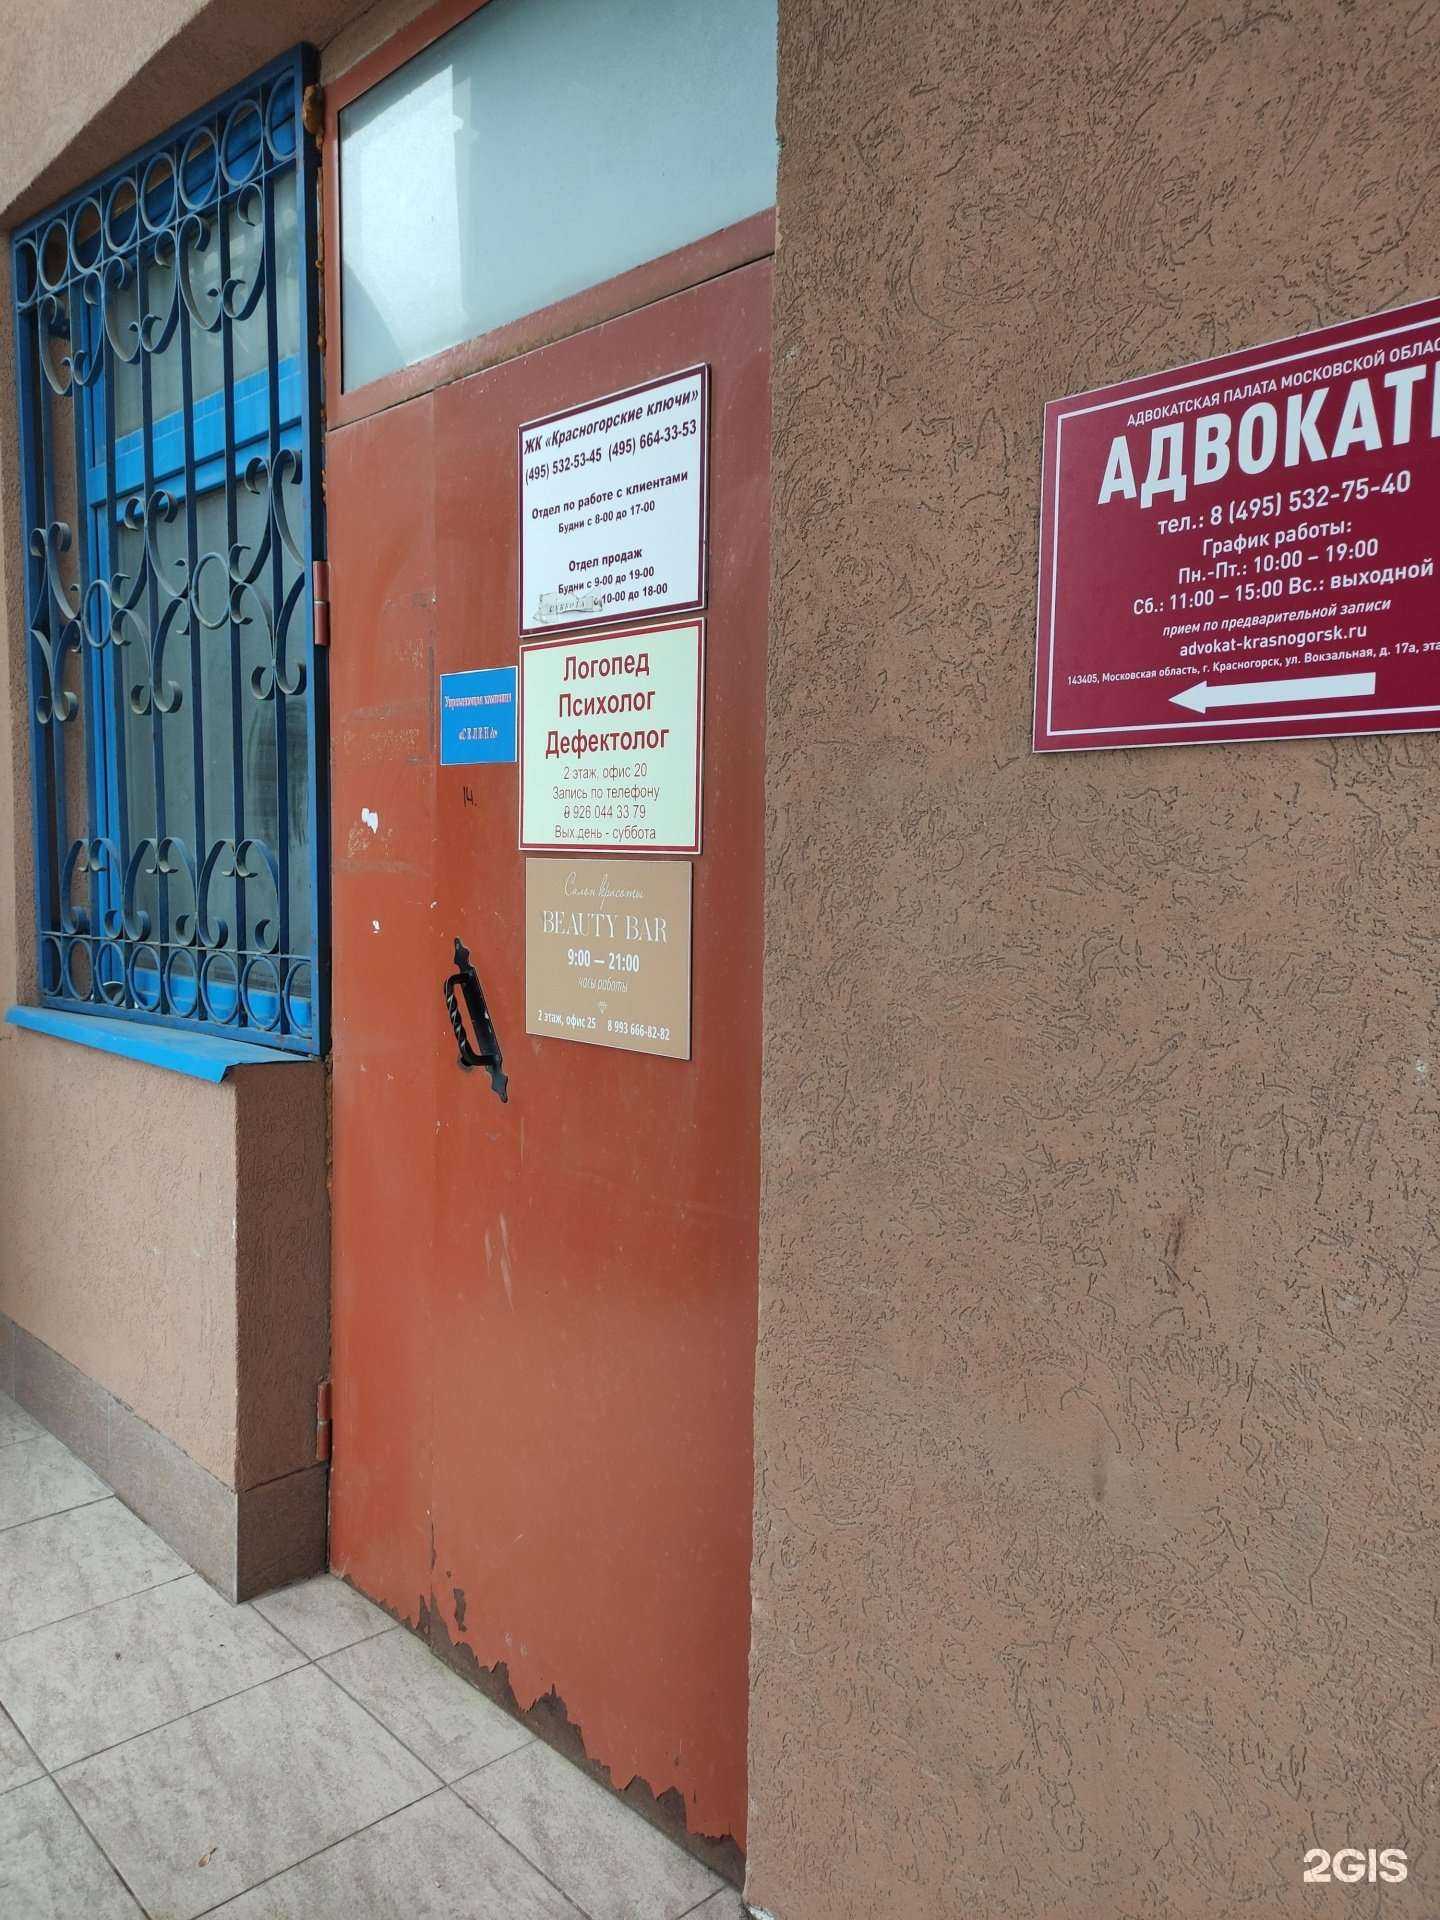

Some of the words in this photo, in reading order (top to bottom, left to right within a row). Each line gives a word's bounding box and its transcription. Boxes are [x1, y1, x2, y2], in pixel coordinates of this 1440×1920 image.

[1127, 393, 1220, 427] АДВОКАТСКАЯ
[1223, 380, 1278, 403] ПАЛАТА
[1281, 349, 1386, 389] МОСКОВСКОЙ
[524, 433, 542, 455] ЖК
[545, 406, 643, 448] «Красногорские
[647, 389, 699, 417] ключи»
[525, 464, 550, 486] (495)
[552, 448, 601, 475] 532-53-45
[608, 437, 636, 462] (495)
[639, 419, 697, 449] 664-33-53
[532, 504, 560, 520] Отдел
[563, 500, 575, 512] по
[578, 490, 613, 511] работе
[616, 487, 622, 498] с
[626, 470, 688, 495] клиентами
[1157, 514, 1204, 535] тел.:
[1210, 505, 1222, 526] 8
[1229, 491, 1282, 525] (495)
[1288, 469, 1411, 512] 532-75-40
[558, 520, 585, 535] Будни
[587, 517, 592, 526] с
[595, 510, 613, 524] 8-00
[615, 510, 627, 521] до
[630, 500, 655, 516] 17-00
[1202, 532, 1270, 558] График
[1274, 521, 1352, 548] работы:
[569, 557, 599, 572] Отдел
[602, 547, 642, 568] продаж
[1178, 561, 1247, 585] Пн.-Пт.:
[1254, 550, 1302, 573] 10:00
[1326, 538, 1379, 563] 19:00
[558, 581, 584, 596] Будни
[586, 579, 592, 589] с
[594, 573, 613, 587] 9-00
[615, 573, 627, 585] до
[630, 566, 655, 581] 19-00
[602, 590, 626, 604] 10-00
[628, 589, 639, 601] до
[643, 583, 668, 597] 18-00
[1133, 597, 1164, 615] Сб.:
[1170, 589, 1214, 610] 11:00
[1235, 579, 1283, 601] 15:00
[1289, 577, 1324, 595] Вс.:
[1330, 558, 1434, 589] выходной
[1162, 623, 1200, 639] прием
[1203, 620, 1218, 632] по
[1221, 604, 1337, 630] предварительной
[1340, 599, 1391, 616] записи
[1180, 625, 1367, 656] advokat-krasnogorsk.ru
[563, 653, 650, 681] Логопед
[1067, 674, 1100, 686] 143405,
[1102, 668, 1156, 683] Московская
[1159, 665, 1200, 677] область,
[1202, 665, 1210, 673] г.
[1213, 658, 1282, 673] Красногорск,
[1285, 656, 1301, 667] ул.
[1304, 648, 1376, 663] Вокзальная,
[1379, 647, 1390, 658] д.
[1395, 642, 1419, 654] 17а,
[559, 691, 656, 717] Психолог
[545, 728, 669, 759] Дефектолог
[564, 766, 569, 780] 2
[602, 764, 631, 781] офис
[634, 762, 648, 777] 20
[552, 786, 588, 800] Запись
[591, 788, 603, 799] по
[607, 784, 660, 802] телефону
[573, 805, 591, 819] 926
[595, 805, 613, 819] 044
[617, 804, 629, 819] 33
[633, 804, 646, 819] 79
[612, 825, 656, 842] суббота
[543, 910, 618, 938] BEAUTY
[624, 915, 668, 943] BAR
[567, 948, 591, 967] 9:00
[608, 952, 640, 972] 21:00
[537, 1009, 543, 1021] 2
[543, 1012, 564, 1026] этаж,
[566, 1013, 585, 1030] офис
[587, 1017, 596, 1029] 25
[607, 1019, 612, 1032] 8
[614, 1021, 628, 1034] 993
[630, 1022, 670, 1041] 666-82-82
